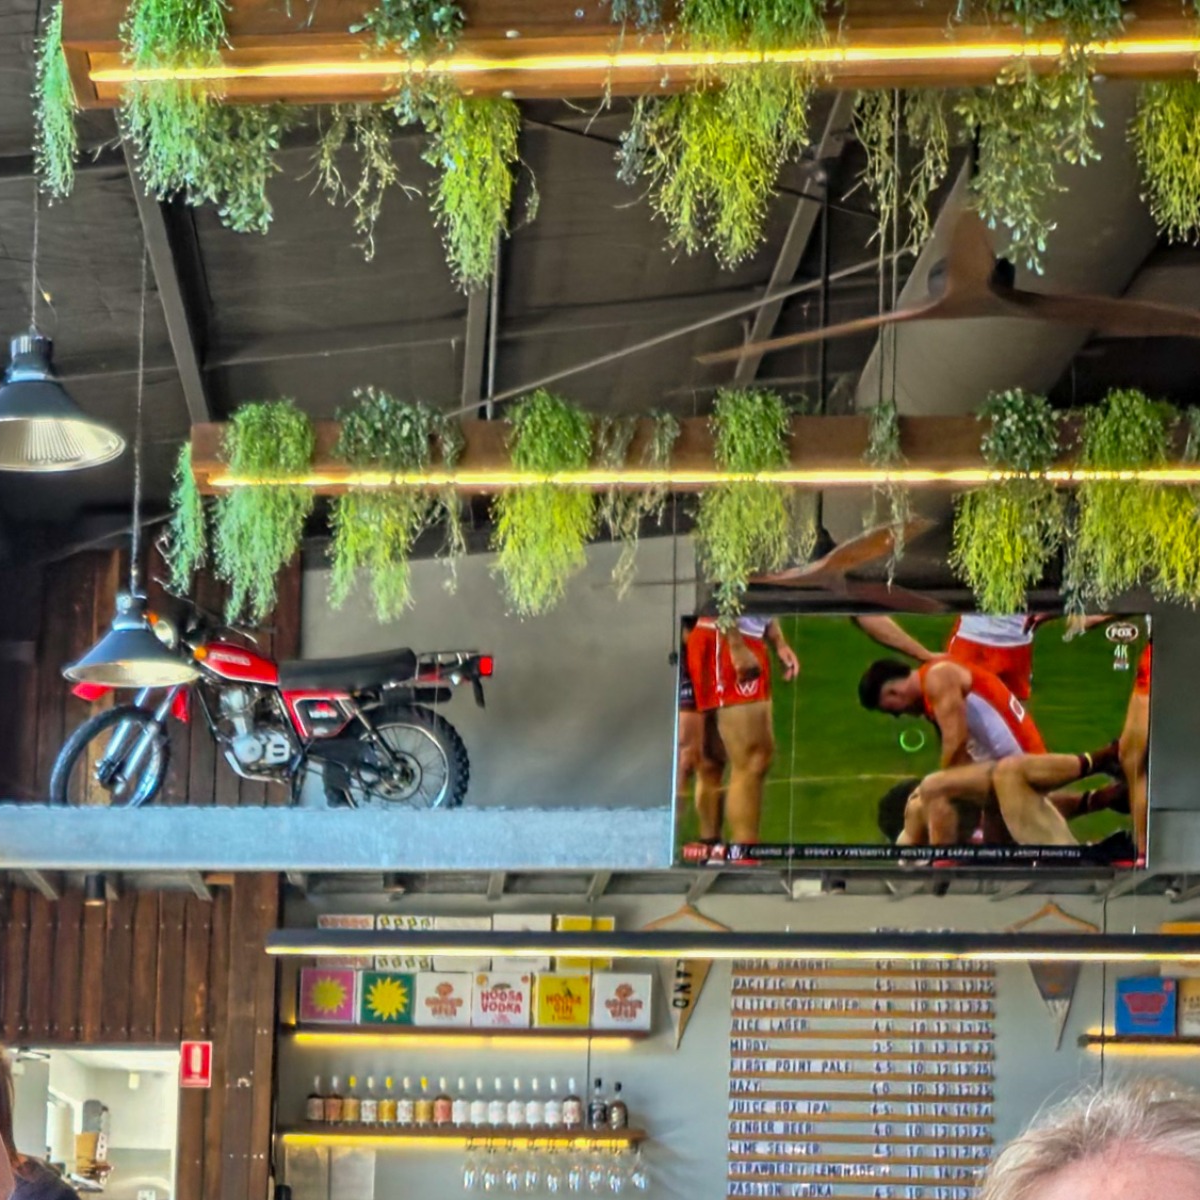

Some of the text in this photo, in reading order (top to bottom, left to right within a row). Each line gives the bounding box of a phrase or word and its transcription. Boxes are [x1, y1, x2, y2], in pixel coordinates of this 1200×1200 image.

[1110, 626, 1133, 638] FOX
[1114, 644, 1129, 660] 4K
[733, 978, 785, 991] PACIFIC
[793, 979, 815, 991] ALE
[481, 990, 523, 1003] NOOSA
[481, 1002, 523, 1014] VODKA
[733, 998, 776, 1011] LITTLE
[784, 999, 814, 1011] COVE
[732, 1019, 760, 1031] RICE
[769, 1019, 808, 1032] LAGER
[730, 1039, 767, 1051] MIDDY
[730, 1060, 767, 1072] FIRST
[775, 1060, 812, 1073] POINT
[821, 1061, 850, 1073] PALE
[730, 1080, 760, 1092] HAZY
[731, 1101, 766, 1114] JUICE
[775, 1101, 798, 1113] BOX
[807, 1102, 829, 1114] IPA
[729, 1121, 775, 1134] GINGER
[783, 1122, 813, 1134] BEER
[729, 1142, 757, 1154] LIME
